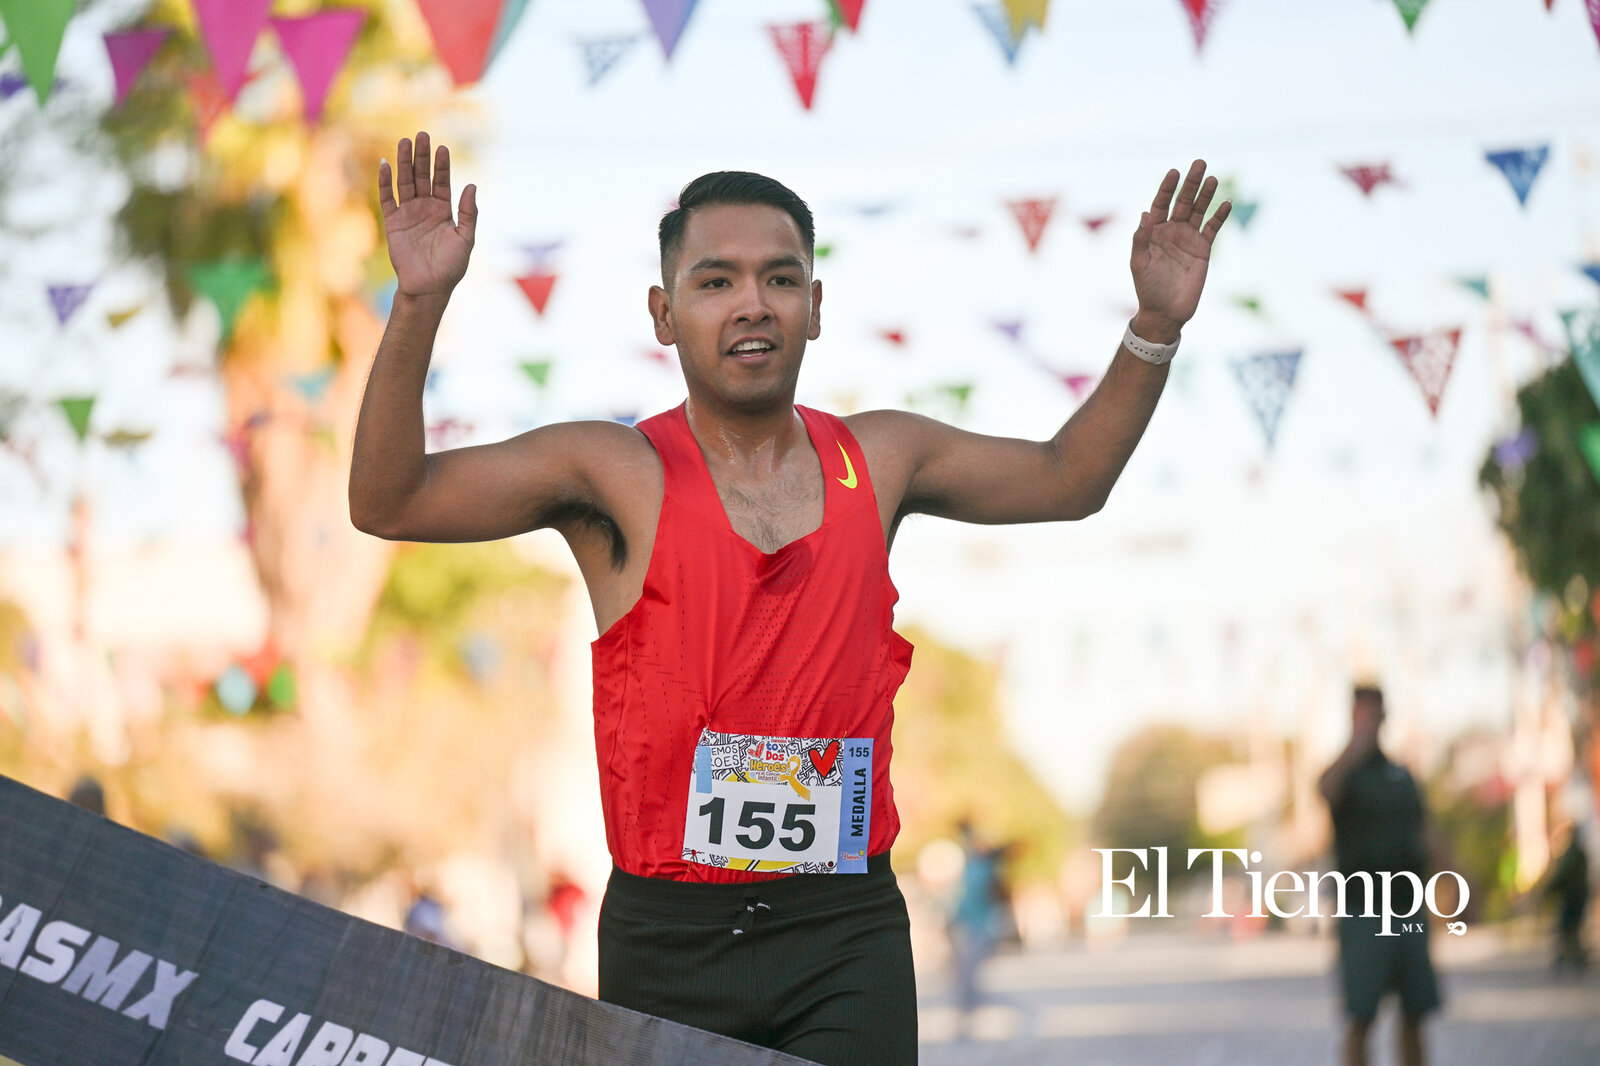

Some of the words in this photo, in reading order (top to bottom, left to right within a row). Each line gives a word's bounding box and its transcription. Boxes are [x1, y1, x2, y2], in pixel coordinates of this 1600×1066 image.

[711, 744, 738, 756] EMOS
[711, 754, 740, 768] OES
[848, 747, 870, 758] 155
[851, 767, 867, 837] MEDALLA
[699, 797, 816, 852] 155
[0, 897, 199, 1030] ASMX
